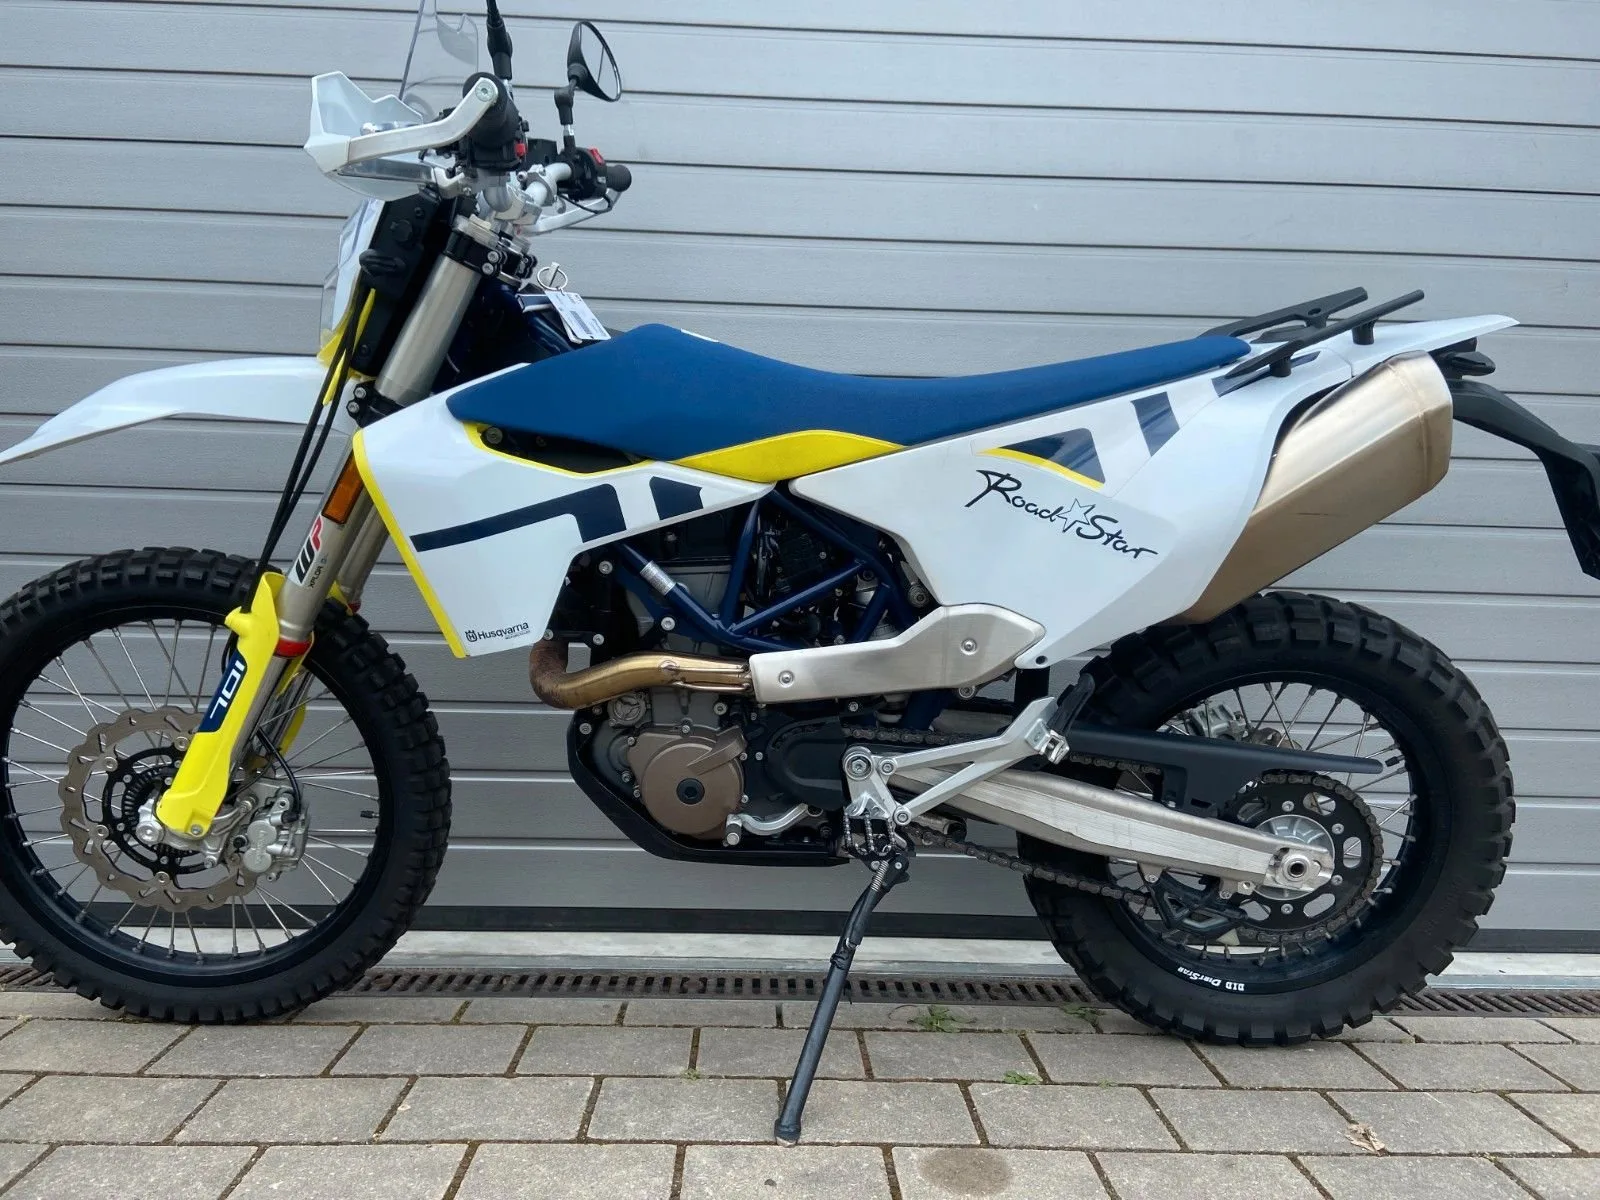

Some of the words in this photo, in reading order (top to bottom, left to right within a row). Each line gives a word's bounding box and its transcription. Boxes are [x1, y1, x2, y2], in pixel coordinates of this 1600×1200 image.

[964, 469, 1064, 522] Road
[1076, 514, 1159, 559] Star
[477, 622, 529, 640] Husqvarna
[210, 660, 245, 719] 701
[1225, 981, 1245, 992] DID
